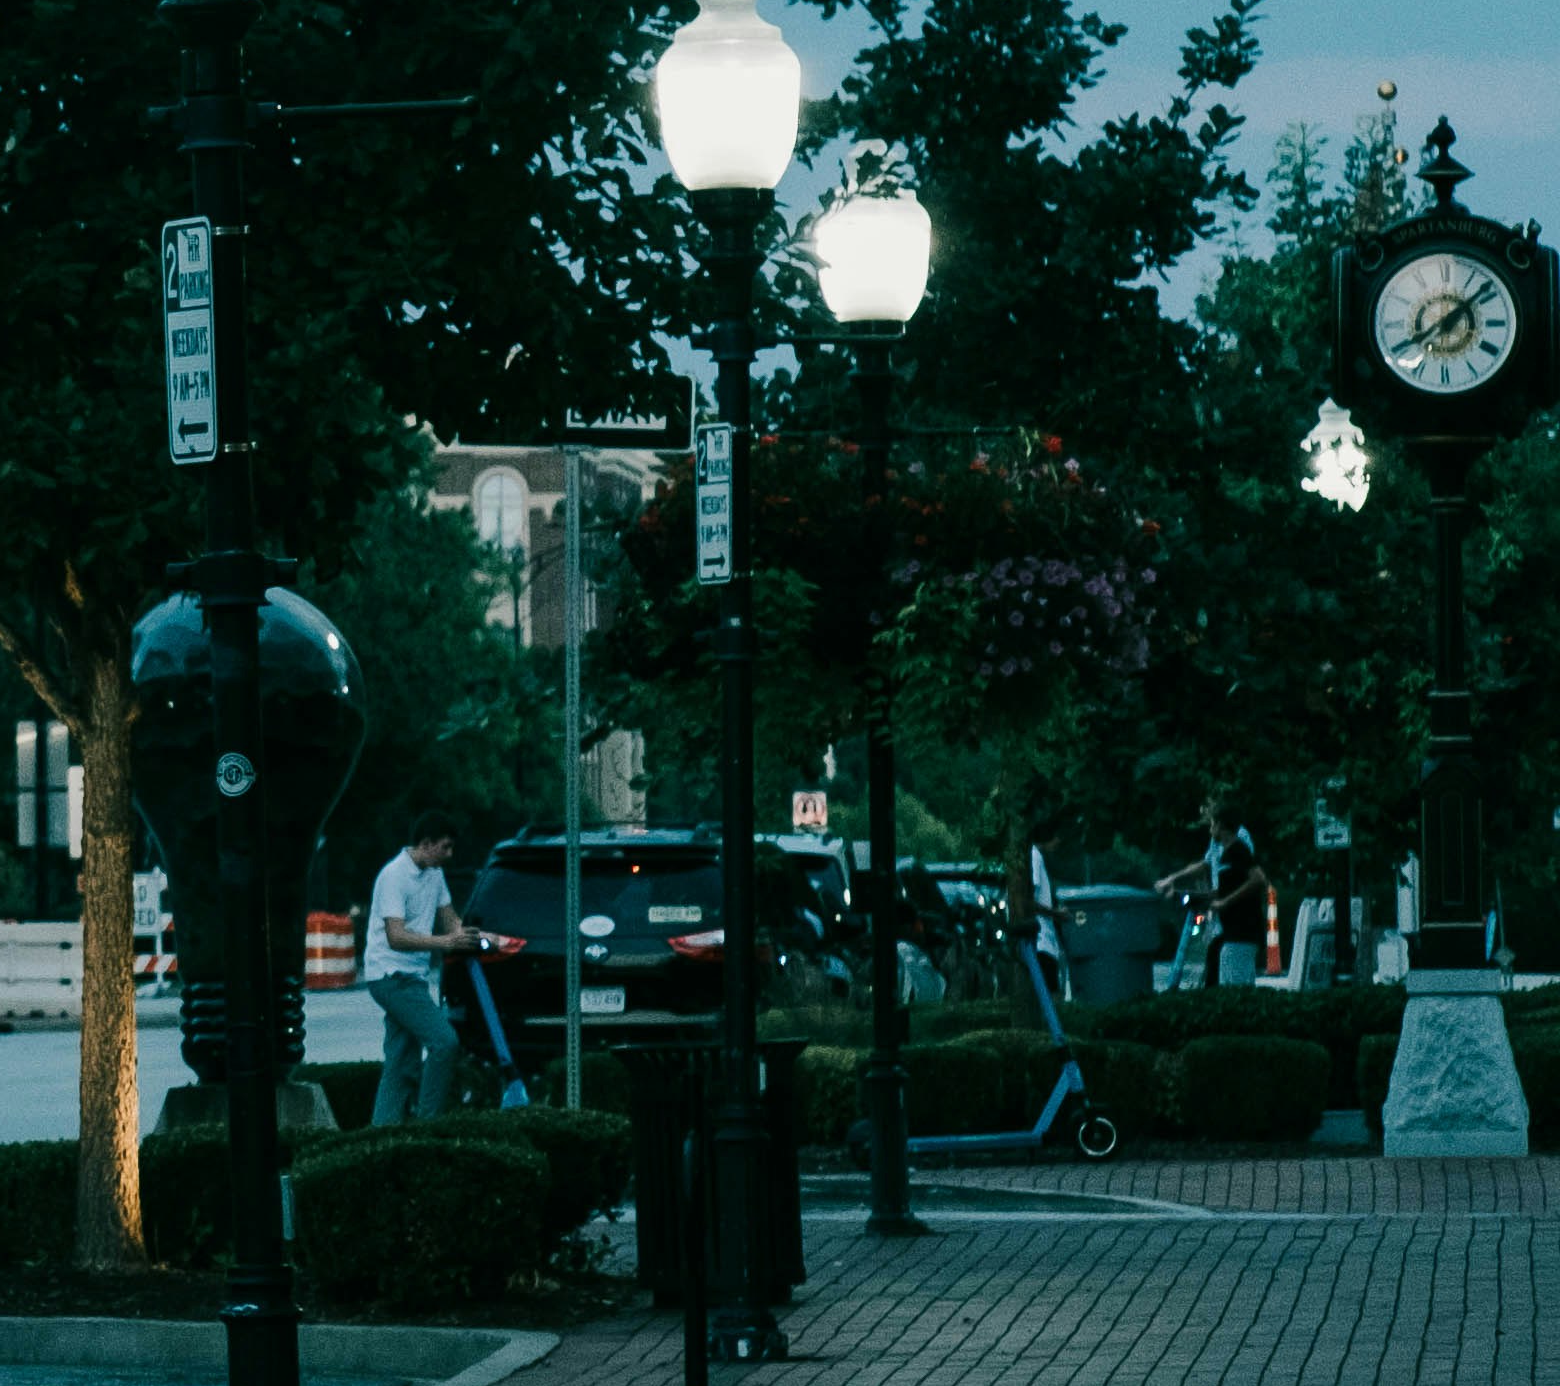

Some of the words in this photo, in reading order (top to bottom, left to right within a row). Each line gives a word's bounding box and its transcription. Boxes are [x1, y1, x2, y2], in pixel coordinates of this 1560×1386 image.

[166, 241, 178, 299] 2
[188, 234, 200, 262] HR
[179, 269, 209, 301] PARKING
[699, 439, 706, 476] 2
